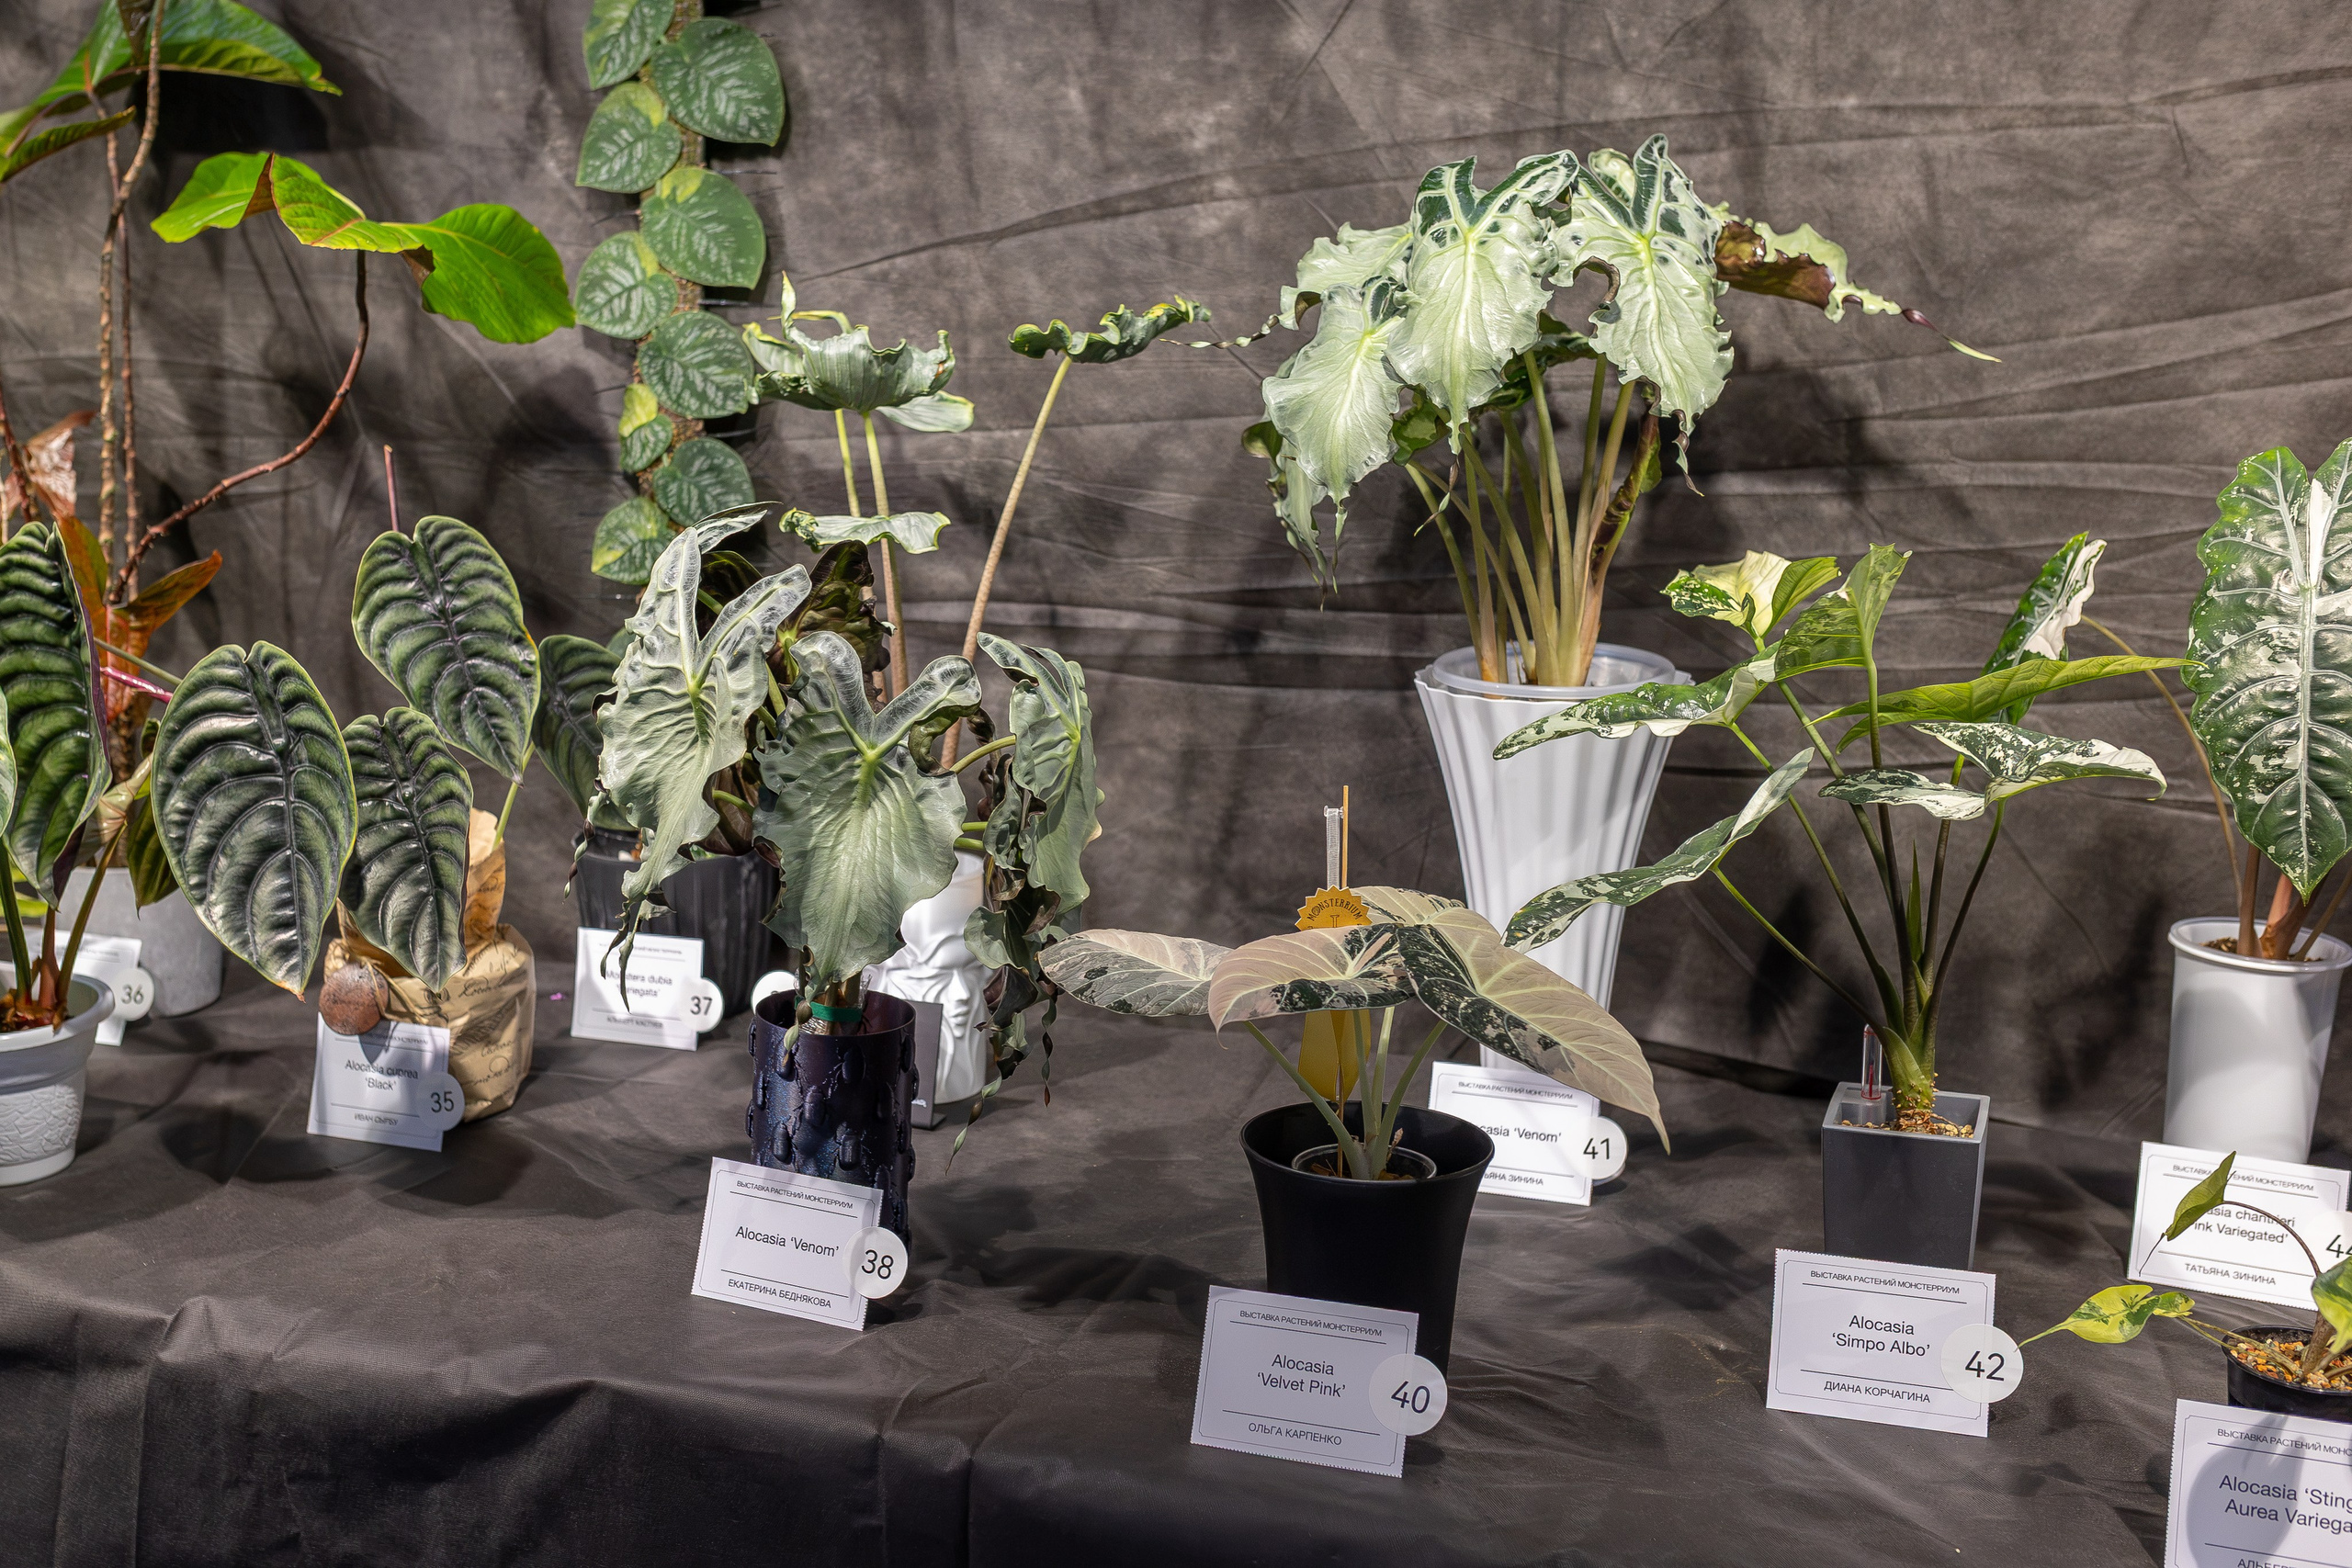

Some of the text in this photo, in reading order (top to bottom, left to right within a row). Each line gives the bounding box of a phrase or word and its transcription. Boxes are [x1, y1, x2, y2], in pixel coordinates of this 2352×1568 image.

[1306, 898, 1363, 921] MONSTERRIUM
[120, 984, 144, 1005] 36
[689, 996, 713, 1016] 37
[345, 1059, 419, 1079] Alocasia cuprea
[1458, 1081, 1491, 1090] ВЫСТАВКА
[1491, 1085, 1525, 1094] РАСТЕНИЙ
[430, 1091, 455, 1113] 35
[1514, 1127, 1562, 1143] ‘Venom’
[1583, 1137, 1610, 1160] 41
[1509, 1174, 1544, 1186] ЗИНИНА
[2256, 1178, 2314, 1191] МОНСТЕРРИУМ
[737, 1179, 854, 1210] ВЫСТАВКА РАСТЕНИЙ МОНСТЕРРИУМ
[735, 1225, 840, 1258] Alocasia ‘Venom’
[2216, 1223, 2288, 1244] Variegated’
[861, 1249, 894, 1280] 38
[2185, 1263, 2277, 1286] ТАТЬЯНА ЗИНИНА
[1810, 1269, 1961, 1294] ВЫСТАВКА РАСТЕНИЙ МОНСТЕРРИУМ
[728, 1279, 832, 1309] ЕКАТЕРИНА БЕДНЯКОВА
[1240, 1310, 1382, 1337] ВЫСТАВКА РАСТЕНИЙ МОНСТЕРРИУМ
[1849, 1314, 1915, 1336] Alocasia
[1832, 1332, 1931, 1358] ‘Simpo Albo’
[1272, 1354, 1334, 1376] Alocasia
[1964, 1350, 2006, 1382] 42
[1257, 1372, 1347, 1398] ‘Velvet Pink’
[1824, 1380, 1931, 1404] ДИАНА КОРЧАГИНА
[1391, 1381, 1430, 1415] 40
[1248, 1422, 1341, 1446] ОЛЬГА КАРПЕНКО
[2217, 1428, 2268, 1444] ВЫСТАВКА
[2269, 1436, 2322, 1452] РАСТЕНИЙ
[2219, 1474, 2297, 1502] Alocasia
[2224, 1498, 2278, 1522] Aurea
